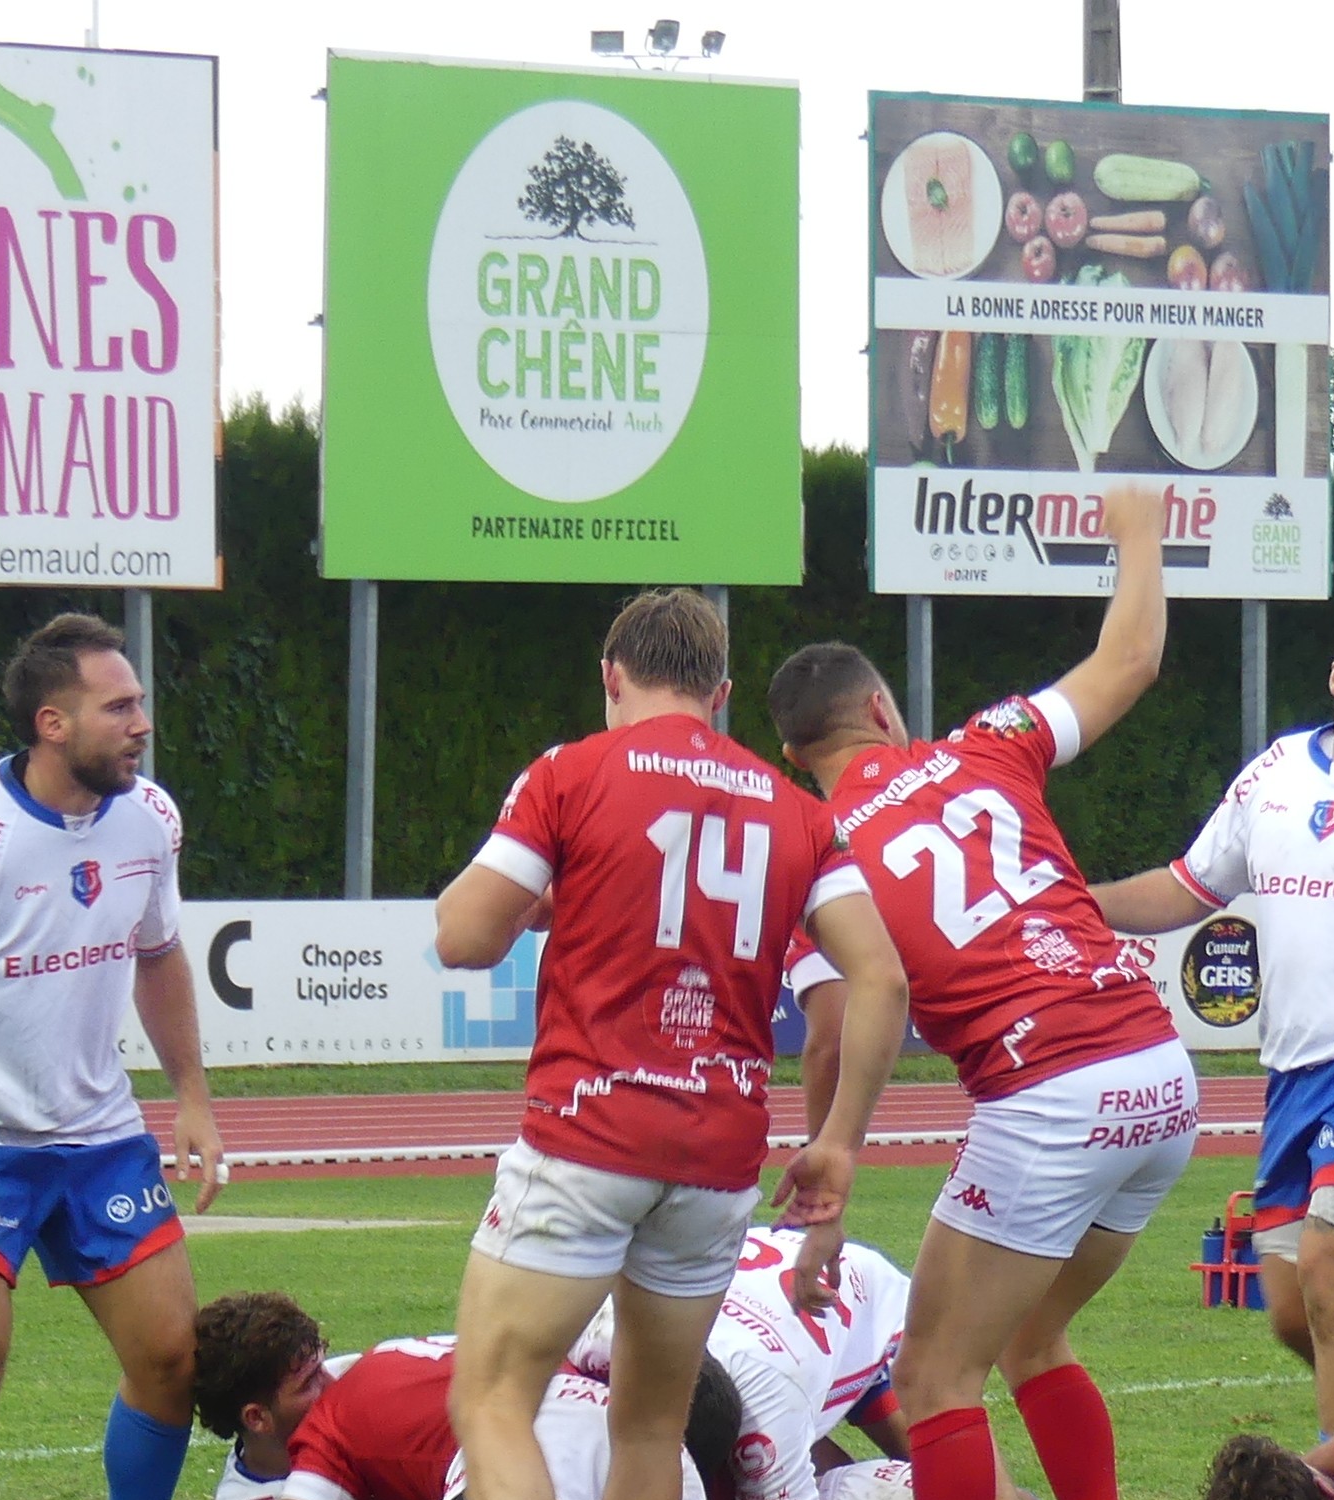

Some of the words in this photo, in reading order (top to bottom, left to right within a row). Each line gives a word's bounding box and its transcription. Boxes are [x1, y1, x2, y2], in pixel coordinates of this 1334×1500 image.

[476, 251, 662, 322] GRAND
[946, 295, 966, 317] LA
[972, 296, 1025, 320] BONNE
[1030, 299, 1098, 323] ADRESSE
[1104, 302, 1144, 325] POUR
[1150, 304, 1198, 328] MIEUX
[1203, 306, 1265, 329] MANGER
[475, 319, 661, 403] CHÊNE
[479, 406, 515, 430] Parc
[520, 407, 614, 432] Commercial
[471, 515, 585, 540] PARTENAIRE
[591, 518, 681, 543] OFFICIEL
[913, 476, 1217, 565] Intermahé
[882, 787, 1065, 951] 22
[646, 810, 771, 962] 14
[3, 941, 127, 979] E.Leclerc
[301, 943, 383, 973] Chapes
[1205, 939, 1251, 957] Canard
[295, 976, 389, 1006] Liquides
[1199, 965, 1253, 988] GERS
[140, 1183, 175, 1214] JO
